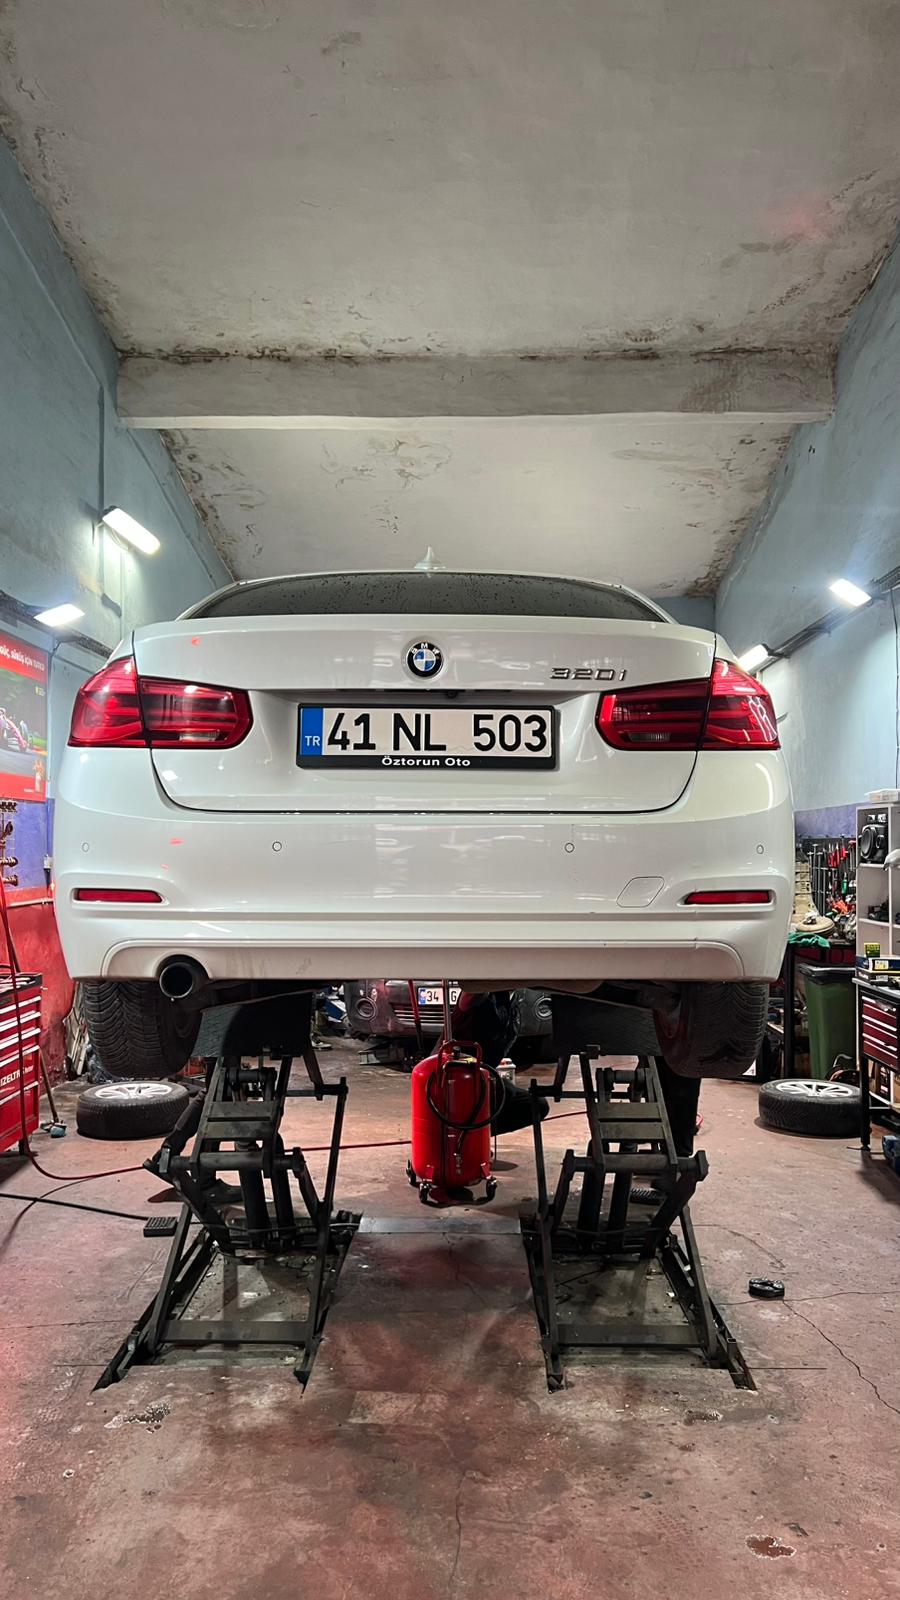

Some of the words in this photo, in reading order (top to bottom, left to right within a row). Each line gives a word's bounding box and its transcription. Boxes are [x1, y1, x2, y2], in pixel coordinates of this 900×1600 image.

[411, 642, 440, 654] BMW
[550, 667, 627, 682] 320i
[305, 735, 321, 747] TR
[327, 712, 376, 751] 41
[393, 712, 447, 751] NL
[473, 713, 547, 752] 503
[381, 755, 440, 767] Öztorun
[444, 757, 471, 767] Oto
[426, 990, 439, 1002] 34
